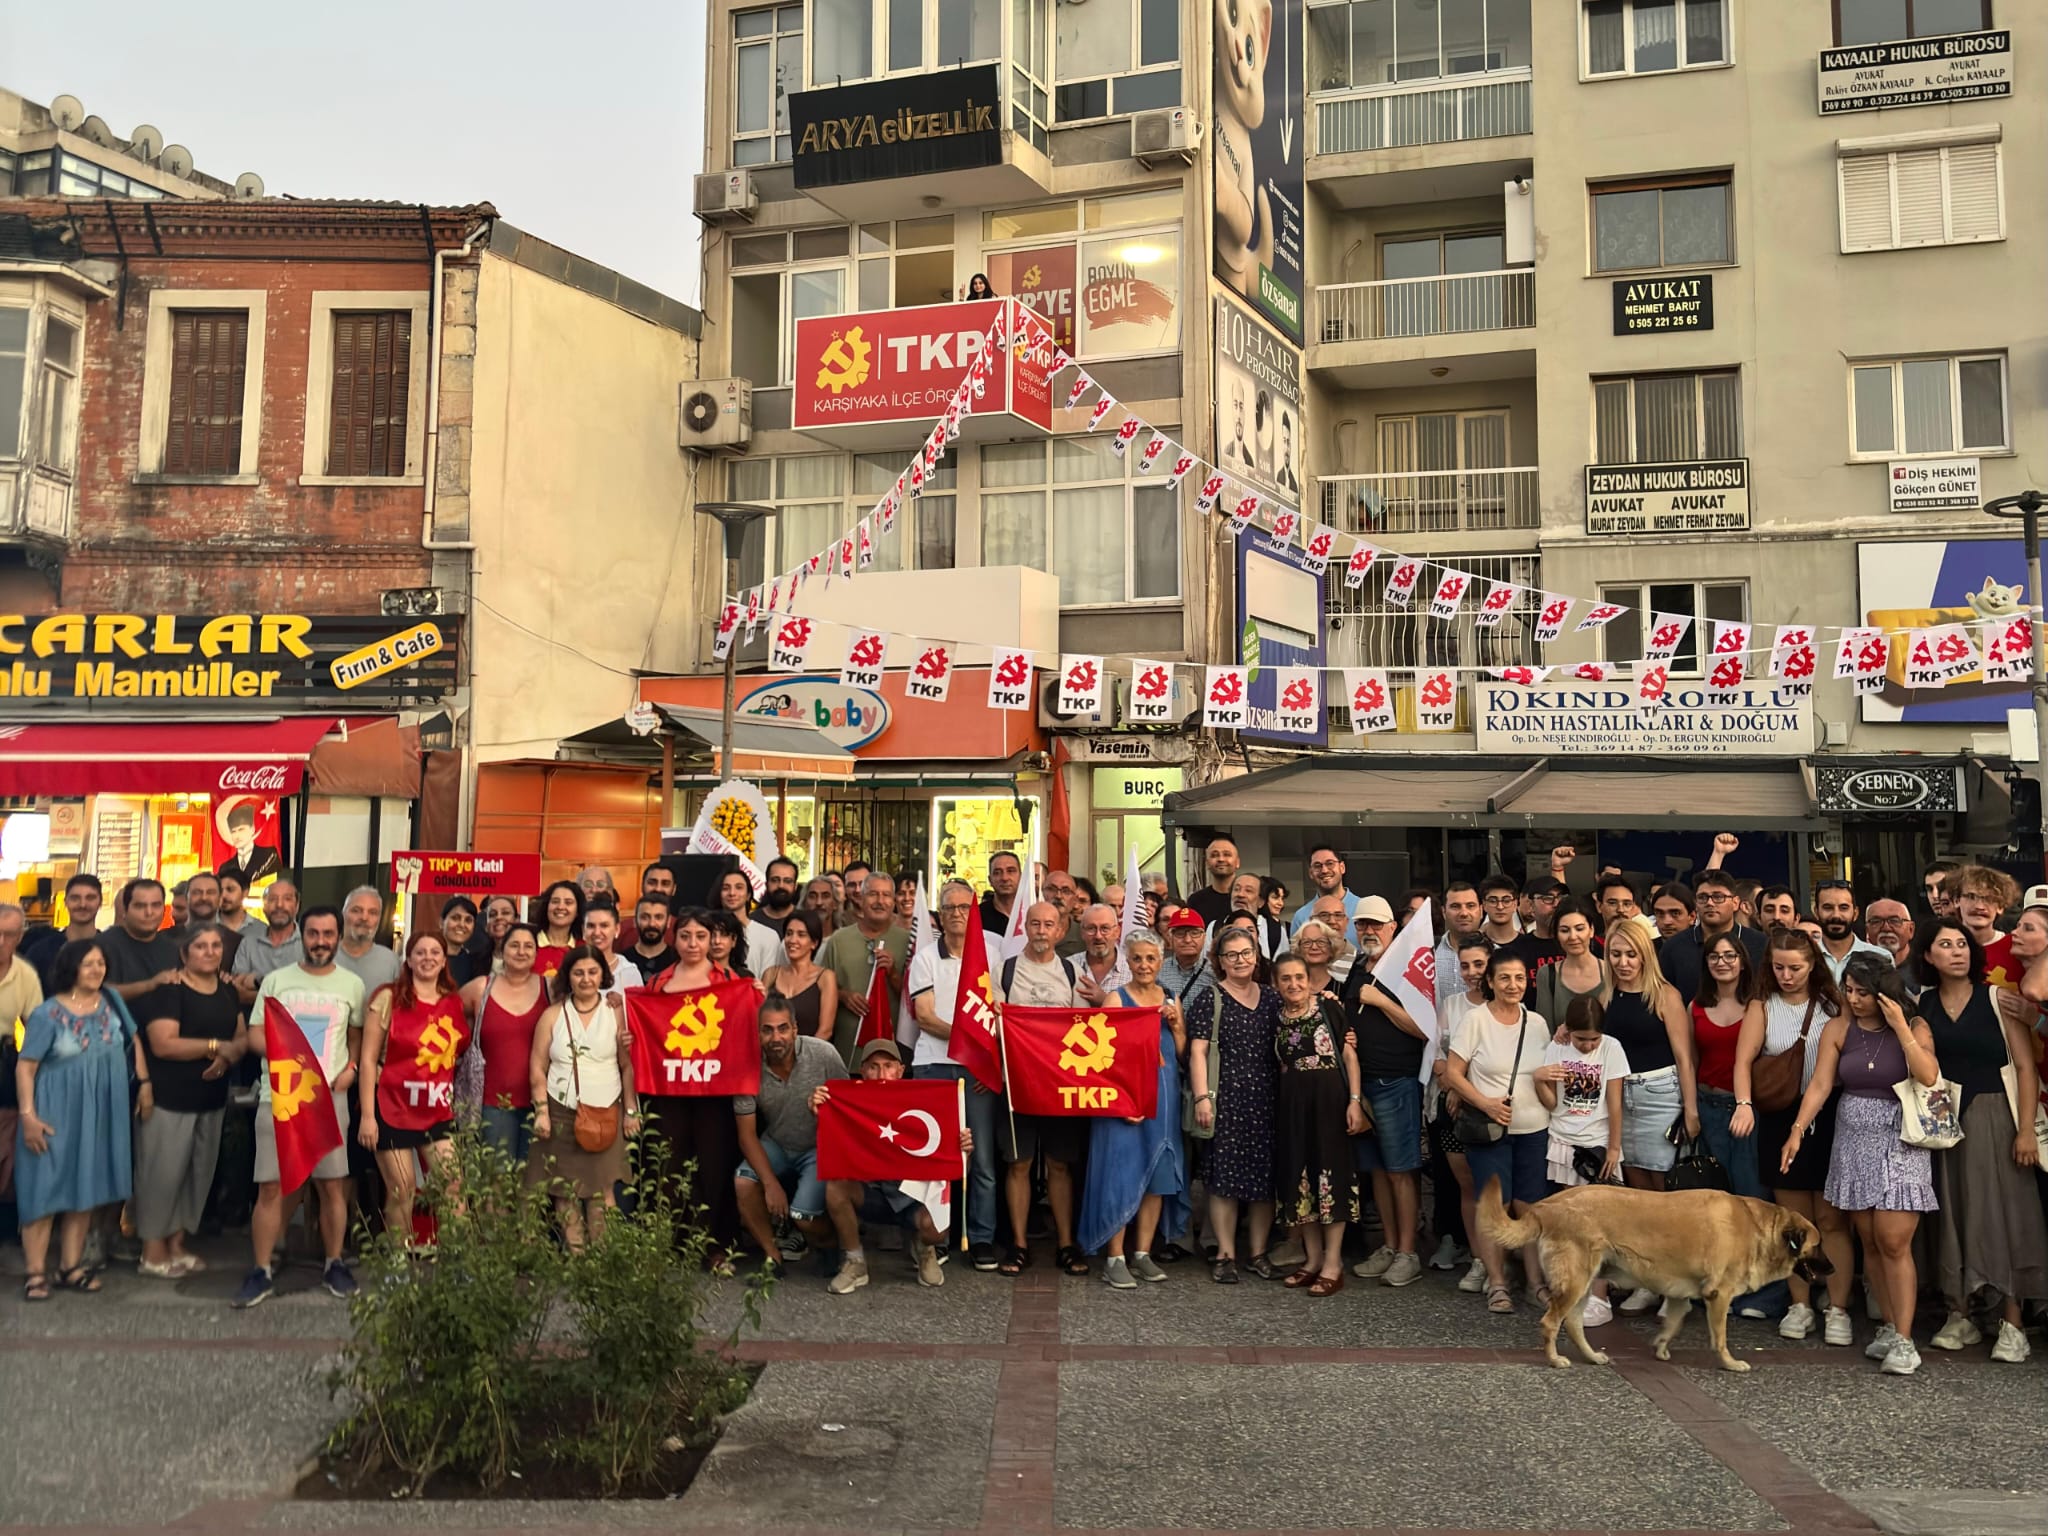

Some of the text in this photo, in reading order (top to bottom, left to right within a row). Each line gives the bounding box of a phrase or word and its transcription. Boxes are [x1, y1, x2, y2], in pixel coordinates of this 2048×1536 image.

[1825, 35, 2005, 68] KAYAALP HUKUK BÜROSU
[1949, 59, 1980, 71] AVUKAT
[1854, 70, 1884, 81] AVUKAT
[1967, 69, 2005, 81] KAYAALP
[1850, 81, 1878, 93] ÖZKAN
[1879, 78, 1915, 90] KAYAALP
[1852, 99, 1863, 108] 90
[1983, 85, 1993, 94] 10
[1995, 84, 2005, 94] 30
[797, 98, 994, 155] ARYA GÜZELLİK
[1087, 261, 1136, 284] BOYUN
[1088, 281, 1138, 314] EĞME
[1261, 272, 1297, 325] özşanal
[1625, 280, 1701, 301] AVUKAT
[1625, 301, 1701, 316] MEHMET BARUT
[1628, 315, 1698, 329] 0 505 221 25 65
[887, 330, 986, 374] TKP
[1246, 322, 1299, 382] HAIR
[1246, 352, 1299, 404] PROTEZ SAÇ
[813, 387, 956, 414] KARŞIYAKA İLÇE ÖRG
[1592, 466, 1741, 492] ZEYDAN HUKUK BÜROSU
[1908, 465, 1976, 481] DİŞ HEKİMİ
[1894, 480, 1976, 496] Gökçen GÜNET
[1591, 497, 1645, 513] AVUKAT
[1671, 495, 1726, 510] AVUKAT
[1590, 516, 1646, 531] MURAT ZEYDAN
[1653, 512, 1744, 529] MEHMET FERHAT ZEYDAN
[1387, 588, 1407, 602] TKP
[1432, 602, 1453, 615] TKP
[0, 614, 315, 659] CARLAR
[1536, 629, 1558, 639] TKP
[334, 631, 436, 685] Fırın & Cafe
[773, 649, 803, 667] TKP
[2008, 657, 2034, 672] TK
[1838, 663, 1854, 674] TK
[1909, 670, 1941, 683] TKP
[1943, 660, 1979, 677] TKP
[1987, 667, 2009, 679] TK
[73, 661, 281, 698] Mamüller
[846, 670, 878, 685] TKP
[910, 682, 943, 698] TKP
[992, 691, 1025, 705] TKP
[1062, 697, 1095, 710] TKP
[1525, 690, 1796, 709] KINDROLU
[815, 698, 877, 734] baby
[1134, 703, 1168, 716] TKP
[1207, 710, 1242, 723] TKP
[1246, 700, 1277, 731] özşana
[1279, 716, 1313, 729] TKP
[1355, 714, 1390, 730] TKP
[1420, 712, 1453, 725] TKP
[1486, 715, 1545, 731] KADIN
[1700, 714, 1713, 731] &
[1721, 710, 1799, 731] DOĞUM
[1511, 734, 1526, 744] Op.
[1528, 734, 1540, 743] Dr.
[1542, 734, 1566, 744] NEŞE
[1568, 732, 1631, 743] KINDIROĞLU
[1642, 734, 1658, 744] Op.
[1659, 734, 1672, 743] Dr.
[1674, 734, 1709, 743] ERGUN
[1711, 732, 1776, 743] KINDIROĞLU
[1089, 738, 1151, 755] Yasemin
[1592, 744, 1615, 752] 369
[1619, 744, 1634, 752] 14
[1638, 744, 1653, 752] 87
[1666, 744, 1690, 752] 369
[1693, 744, 1709, 752] 09
[1712, 744, 1728, 752] 61
[218, 765, 289, 790] Coca-Cola
[1856, 774, 1914, 792] ŞEBNEM
[1124, 781, 1164, 797] BURÇ
[1874, 795, 1898, 805] No:7
[428, 857, 504, 875] TKP'ye Katıl
[434, 874, 497, 888] GÖNÜLLÜ OL!
[662, 1058, 722, 1083] TKP
[1058, 1086, 1119, 1109] TKP
